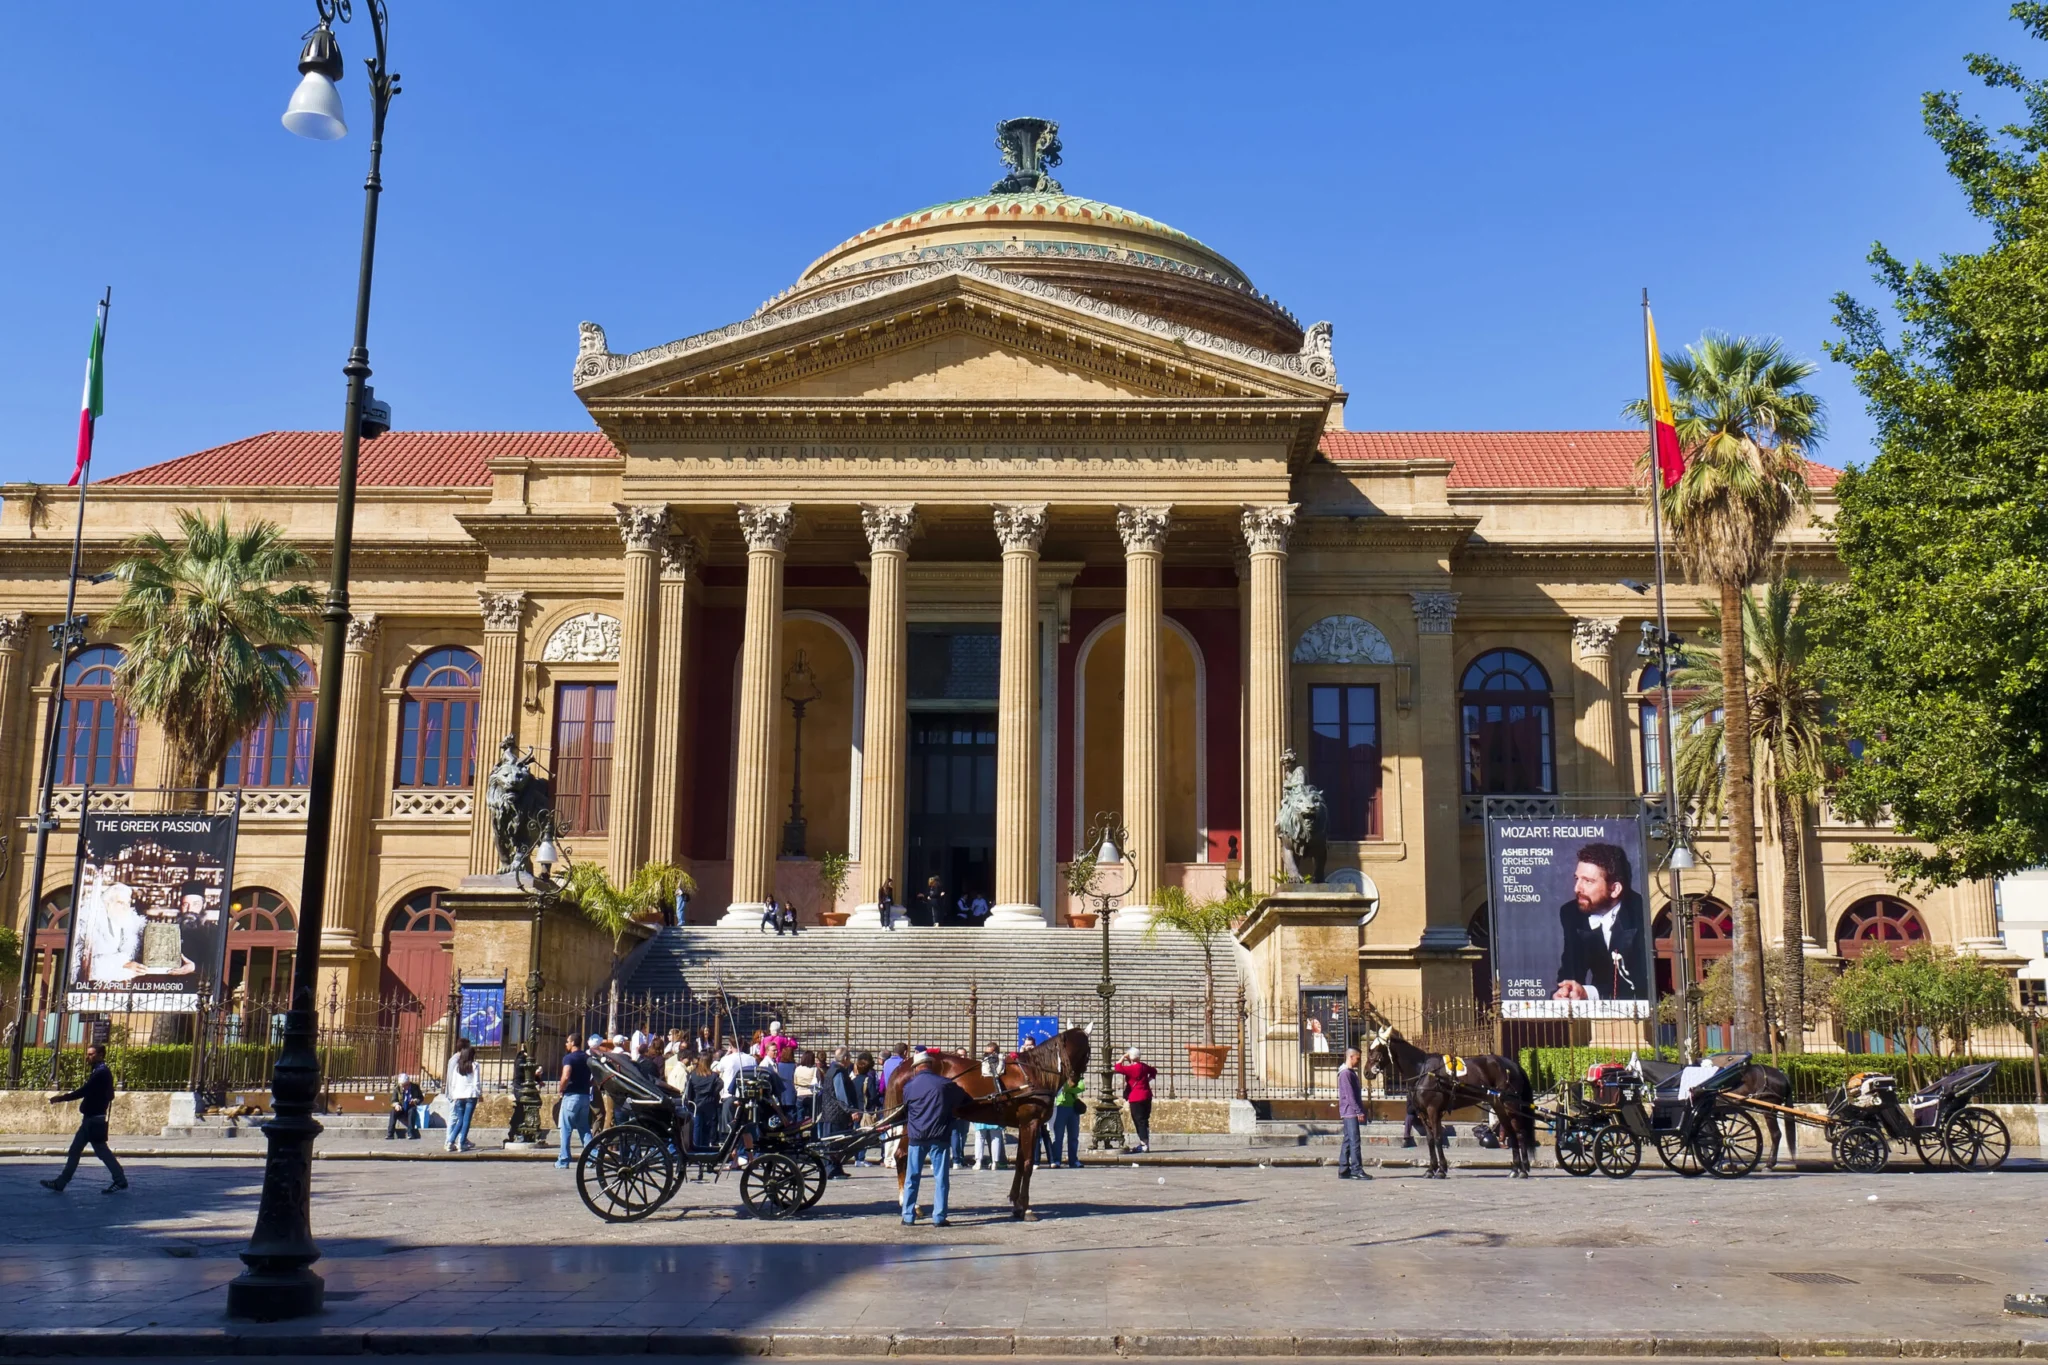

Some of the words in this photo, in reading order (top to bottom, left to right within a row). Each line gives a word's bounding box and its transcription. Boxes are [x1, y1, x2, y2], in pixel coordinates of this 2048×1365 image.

[800, 446, 880, 459] RINNOVA
[909, 446, 972, 459] POPOLI
[984, 446, 992, 459] E
[1003, 447, 1026, 459] NE
[1144, 447, 1187, 460] VITA
[725, 461, 766, 470] DELLE
[777, 461, 826, 470] SCENE
[836, 461, 849, 470] IL
[859, 461, 919, 470] DILETTO
[930, 461, 958, 470] OVE
[968, 461, 1000, 470] NON
[1012, 461, 1045, 471] MIRI
[1055, 461, 1062, 471] A
[1072, 461, 1146, 471] PREPARAR
[95, 820, 119, 832] THE
[120, 820, 159, 832] GREEK
[161, 821, 211, 833] PASSION
[1501, 826, 1550, 838] MOZART:
[1553, 826, 1604, 838] REQUIEM
[1501, 848, 1529, 857] ASHER
[1530, 848, 1553, 857] FISCH
[1502, 857, 1550, 866] ORCHESTRA
[1502, 867, 1508, 875] E
[1509, 867, 1532, 875] CORO
[1503, 876, 1519, 884] DEL
[1503, 885, 1534, 893] TEATRO
[1504, 894, 1541, 903] MASSIMO
[76, 982, 91, 990] DAL
[93, 982, 102, 990] 29
[103, 982, 131, 990] APRILE
[132, 982, 152, 991] ALL'8
[153, 983, 184, 991] MAGGIO
[1507, 979, 1513, 987] 3
[1514, 979, 1542, 987] APRILE
[1508, 988, 1525, 997] ORE
[1527, 988, 1546, 997] 18.30
